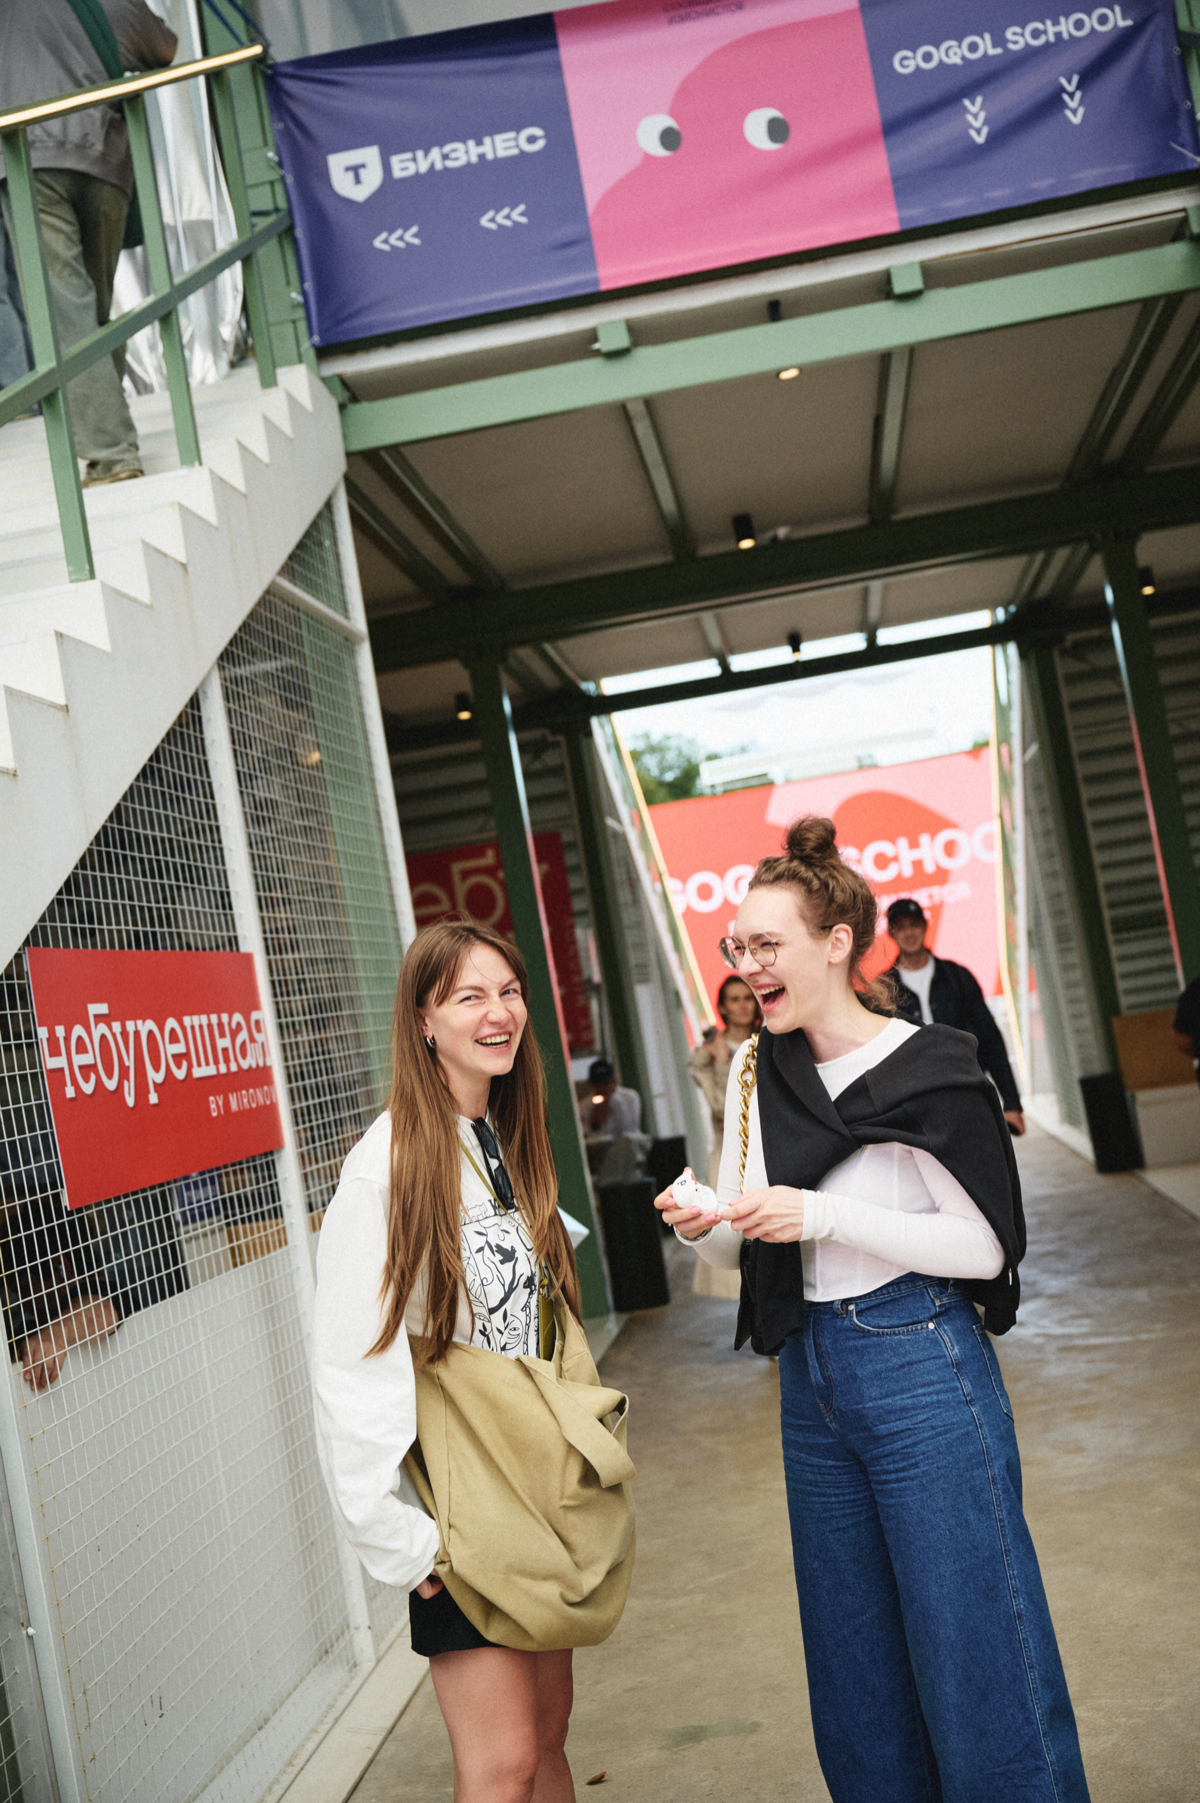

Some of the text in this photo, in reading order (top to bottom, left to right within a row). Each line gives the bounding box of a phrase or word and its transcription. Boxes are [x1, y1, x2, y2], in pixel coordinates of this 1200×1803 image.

[892, 3, 1135, 75] GOGOL SCHOOL
[389, 126, 548, 181] БИЗНЕС
[838, 820, 997, 884] SCHOO
[208, 1094, 225, 1118] BY
